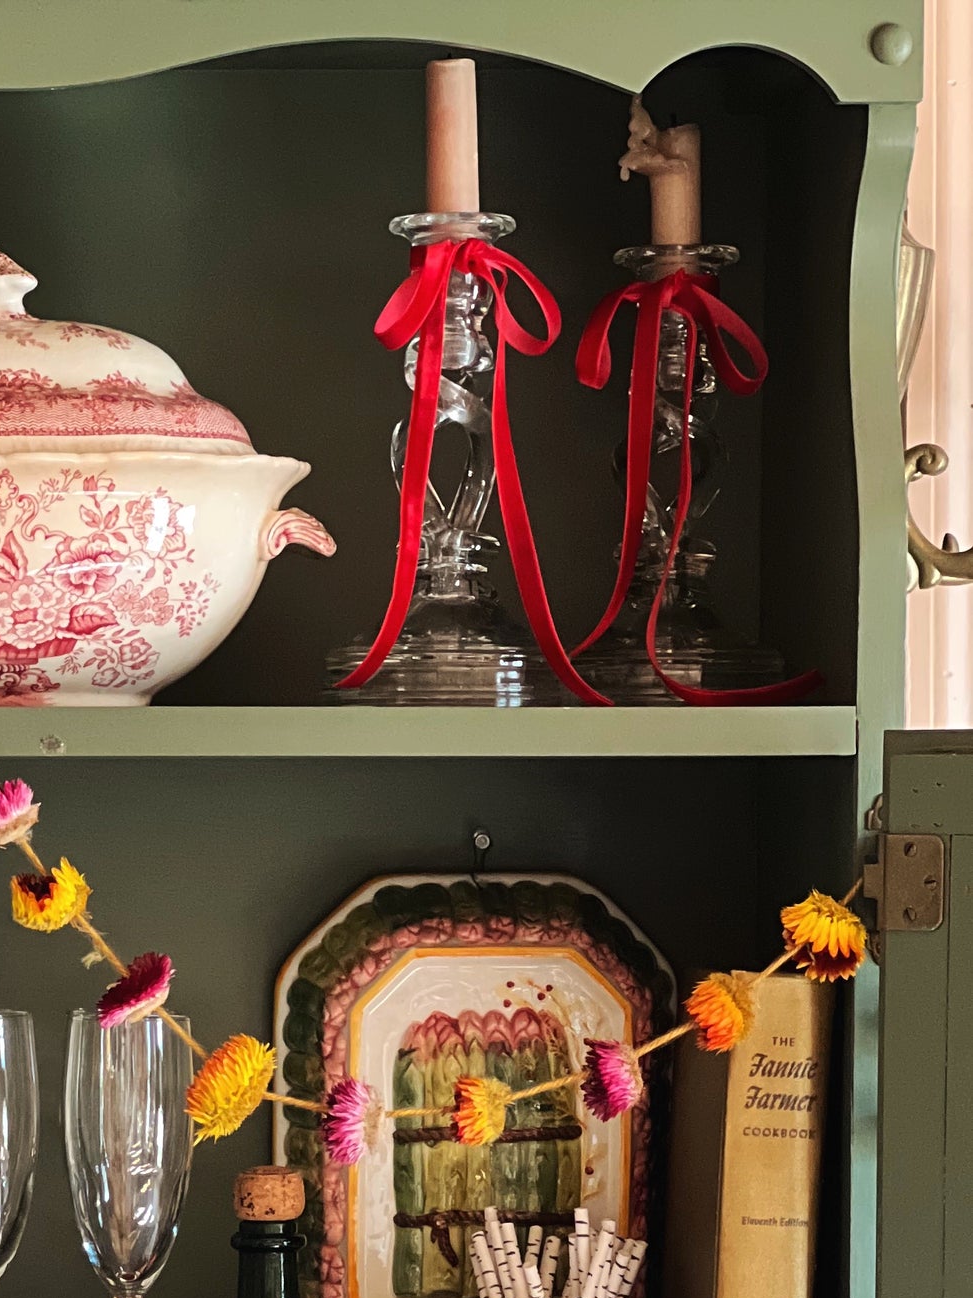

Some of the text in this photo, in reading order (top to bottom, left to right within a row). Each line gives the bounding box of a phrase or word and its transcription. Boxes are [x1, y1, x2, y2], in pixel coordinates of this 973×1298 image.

[772, 1036, 795, 1047] THE
[749, 1053, 819, 1080] Fannie
[744, 1085, 816, 1112] Farmer
[743, 1126, 816, 1140] COOKBOOK
[741, 1216, 778, 1226] Eleventh
